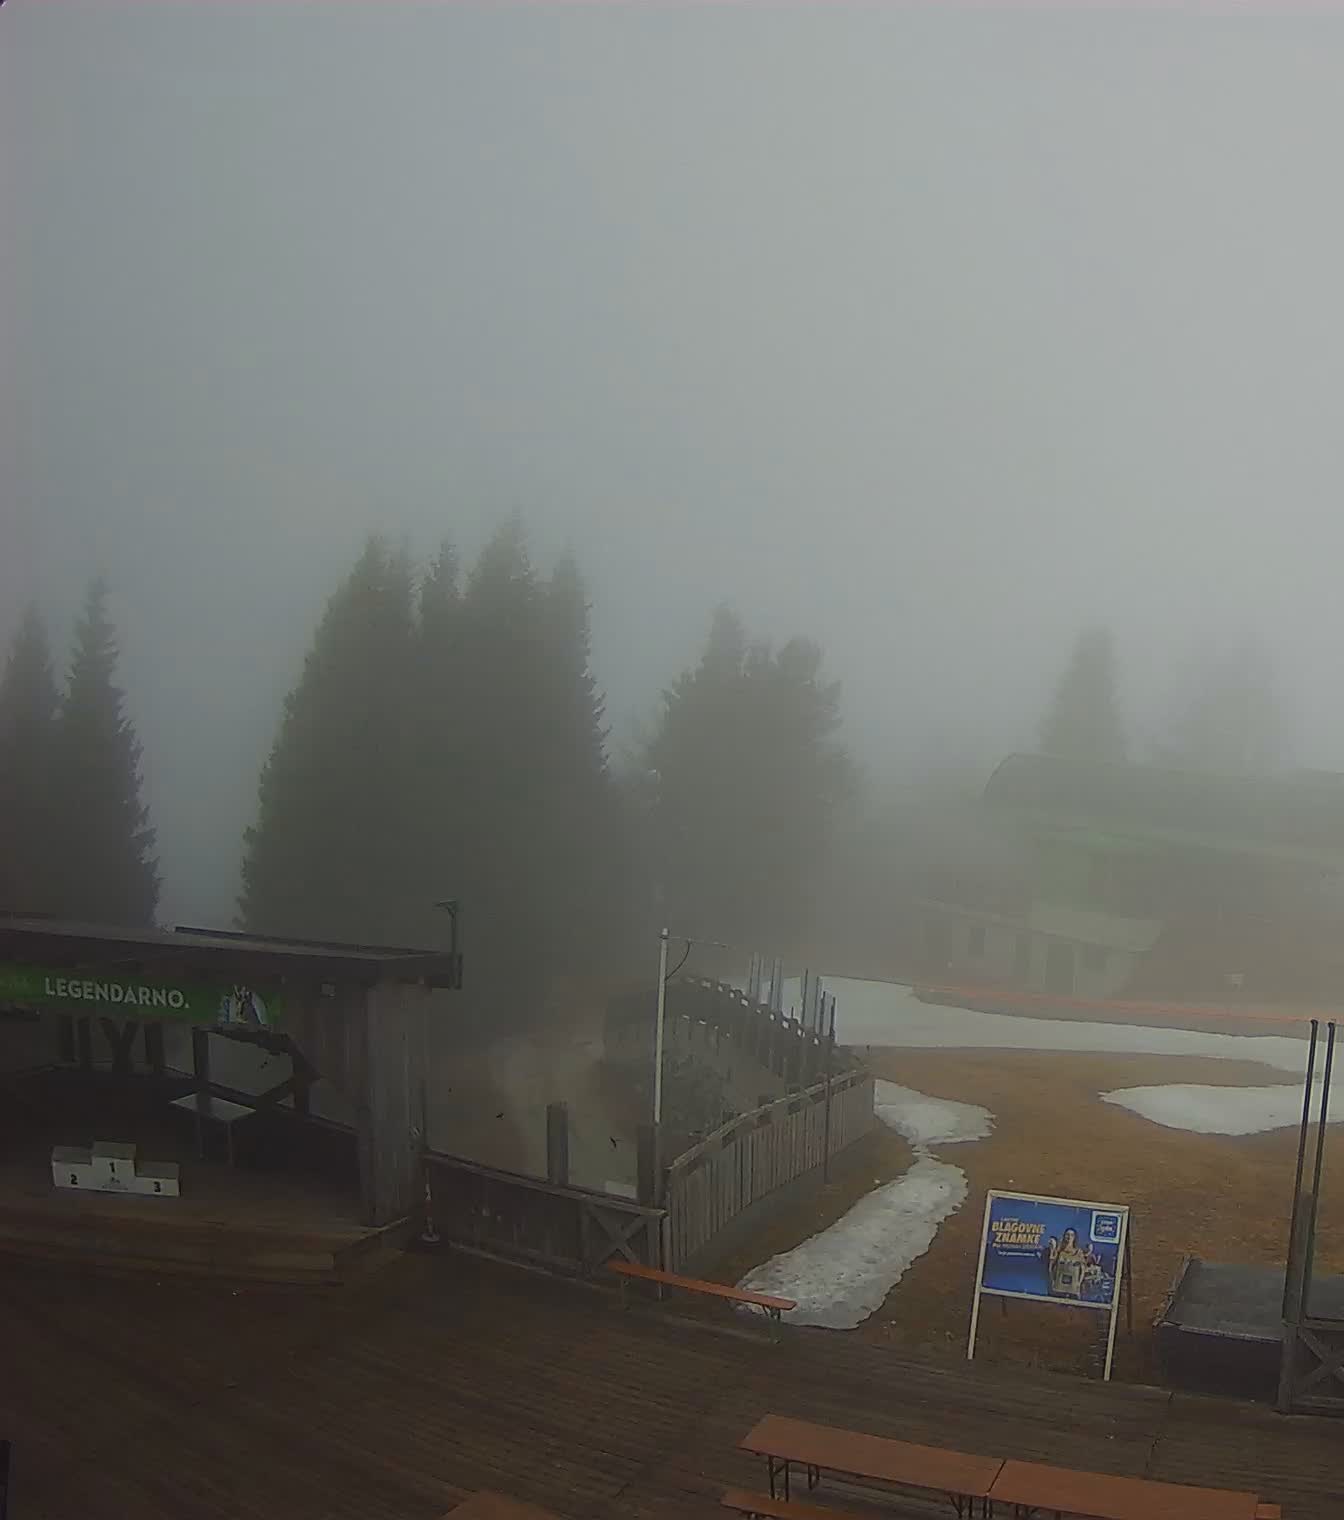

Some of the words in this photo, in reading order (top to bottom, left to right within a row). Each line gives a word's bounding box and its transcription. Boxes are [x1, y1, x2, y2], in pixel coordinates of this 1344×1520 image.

[44, 977, 190, 1009] LEGENDARNO.
[108, 1162, 116, 1173] 1
[69, 1173, 79, 1185] 2
[153, 1181, 162, 1192] 3
[992, 1221, 1047, 1234] BLAGOVNE
[994, 1232, 1041, 1244] ZNAMKE
